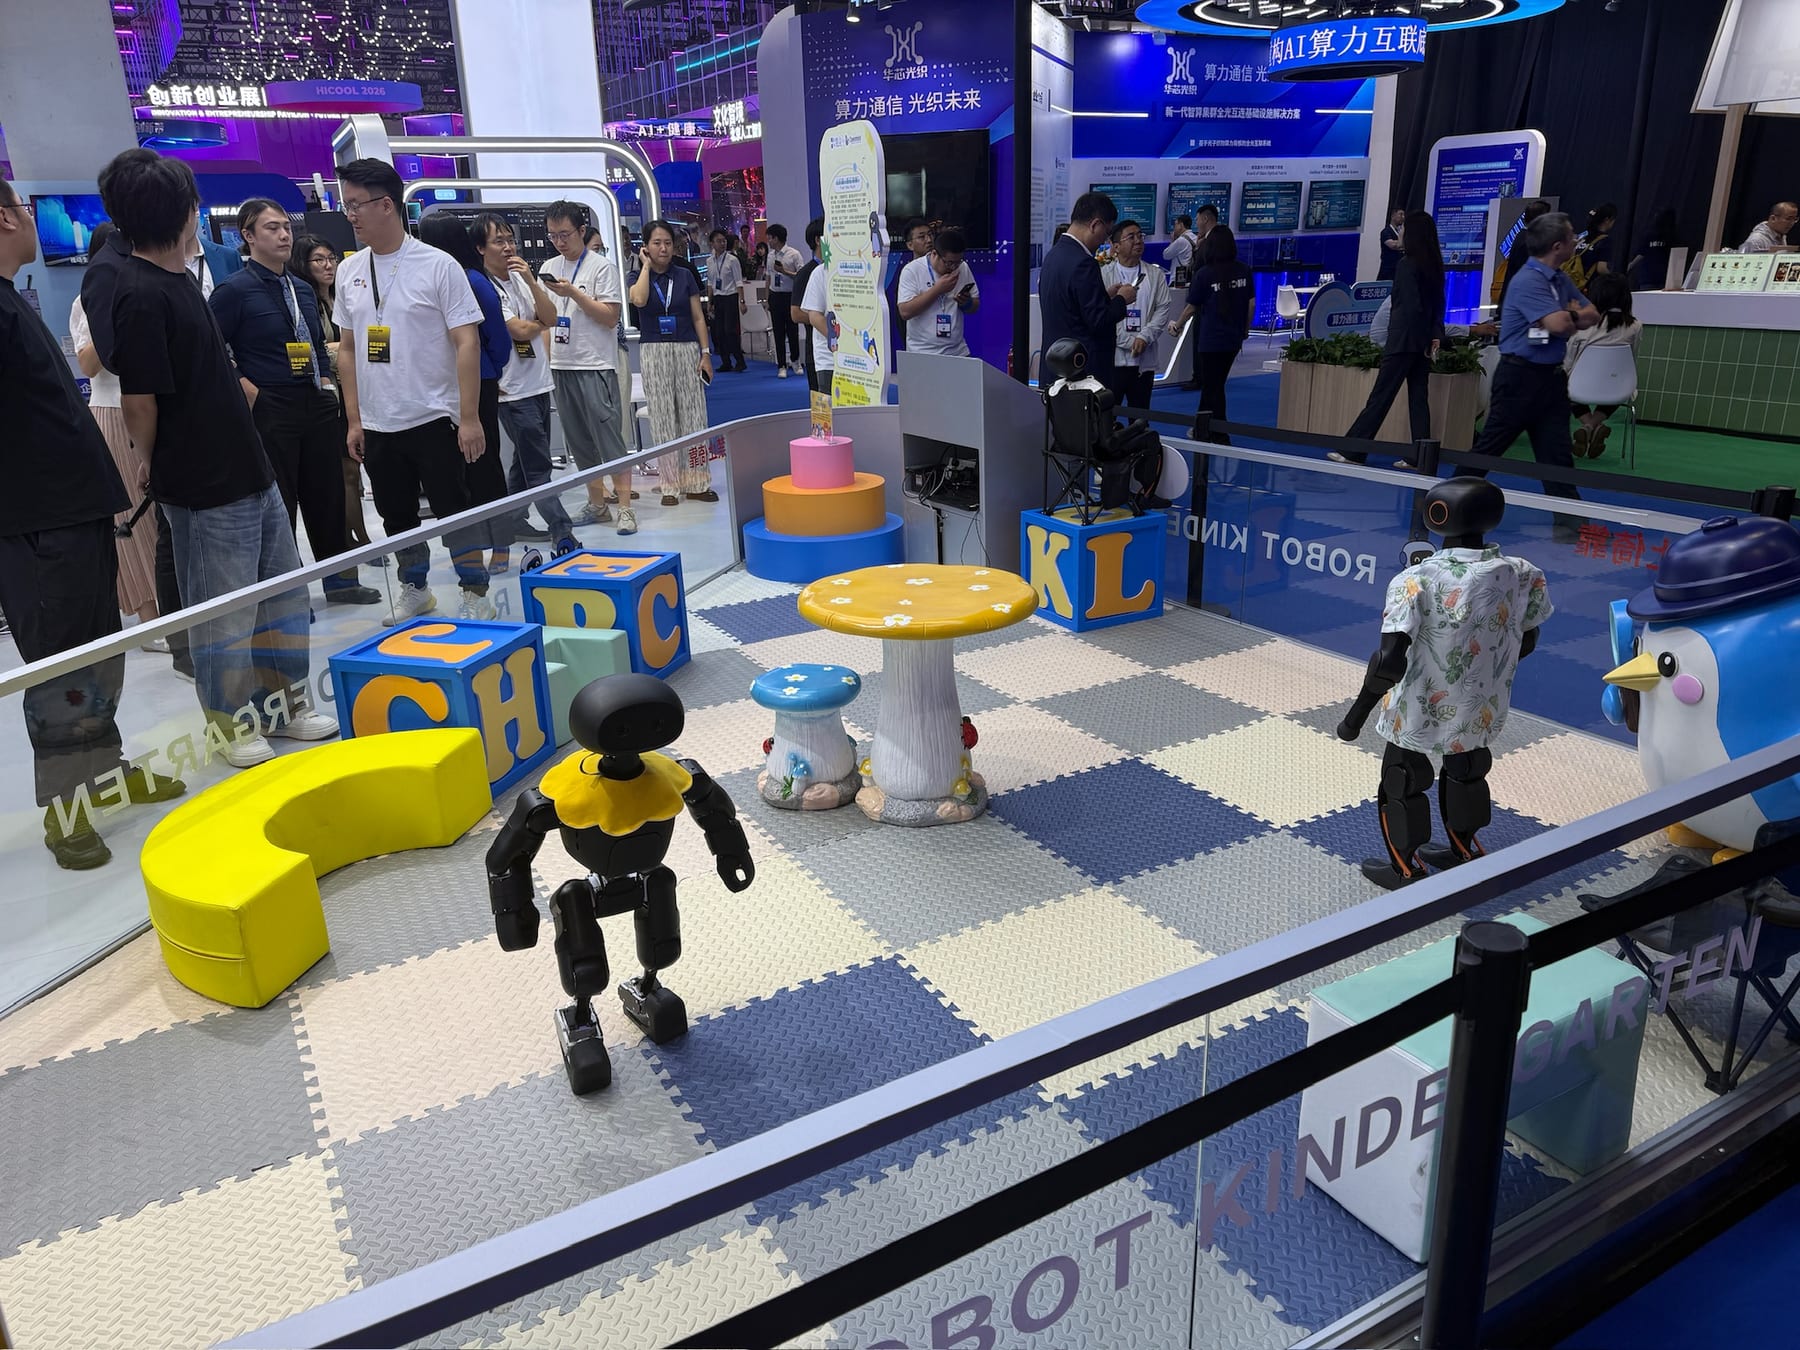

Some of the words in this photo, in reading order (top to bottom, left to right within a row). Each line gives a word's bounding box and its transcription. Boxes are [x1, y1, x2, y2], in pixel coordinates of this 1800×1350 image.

[1268, 25, 1427, 66] 构AI算力互联底
[316, 86, 359, 95] HICOOL
[883, 65, 928, 81] 华芯光织
[1204, 63, 1254, 82] 算力通信
[1255, 65, 1270, 82] 光
[147, 84, 261, 107] 创新创业展
[834, 95, 903, 120] 算力通信
[908, 88, 982, 114] 光织未来
[1027, 525, 1073, 619] K
[1085, 532, 1156, 619] L
[638, 573, 681, 668] C
[472, 646, 546, 783] H
[1199, 915, 1763, 1249] KINDEGARTEN
